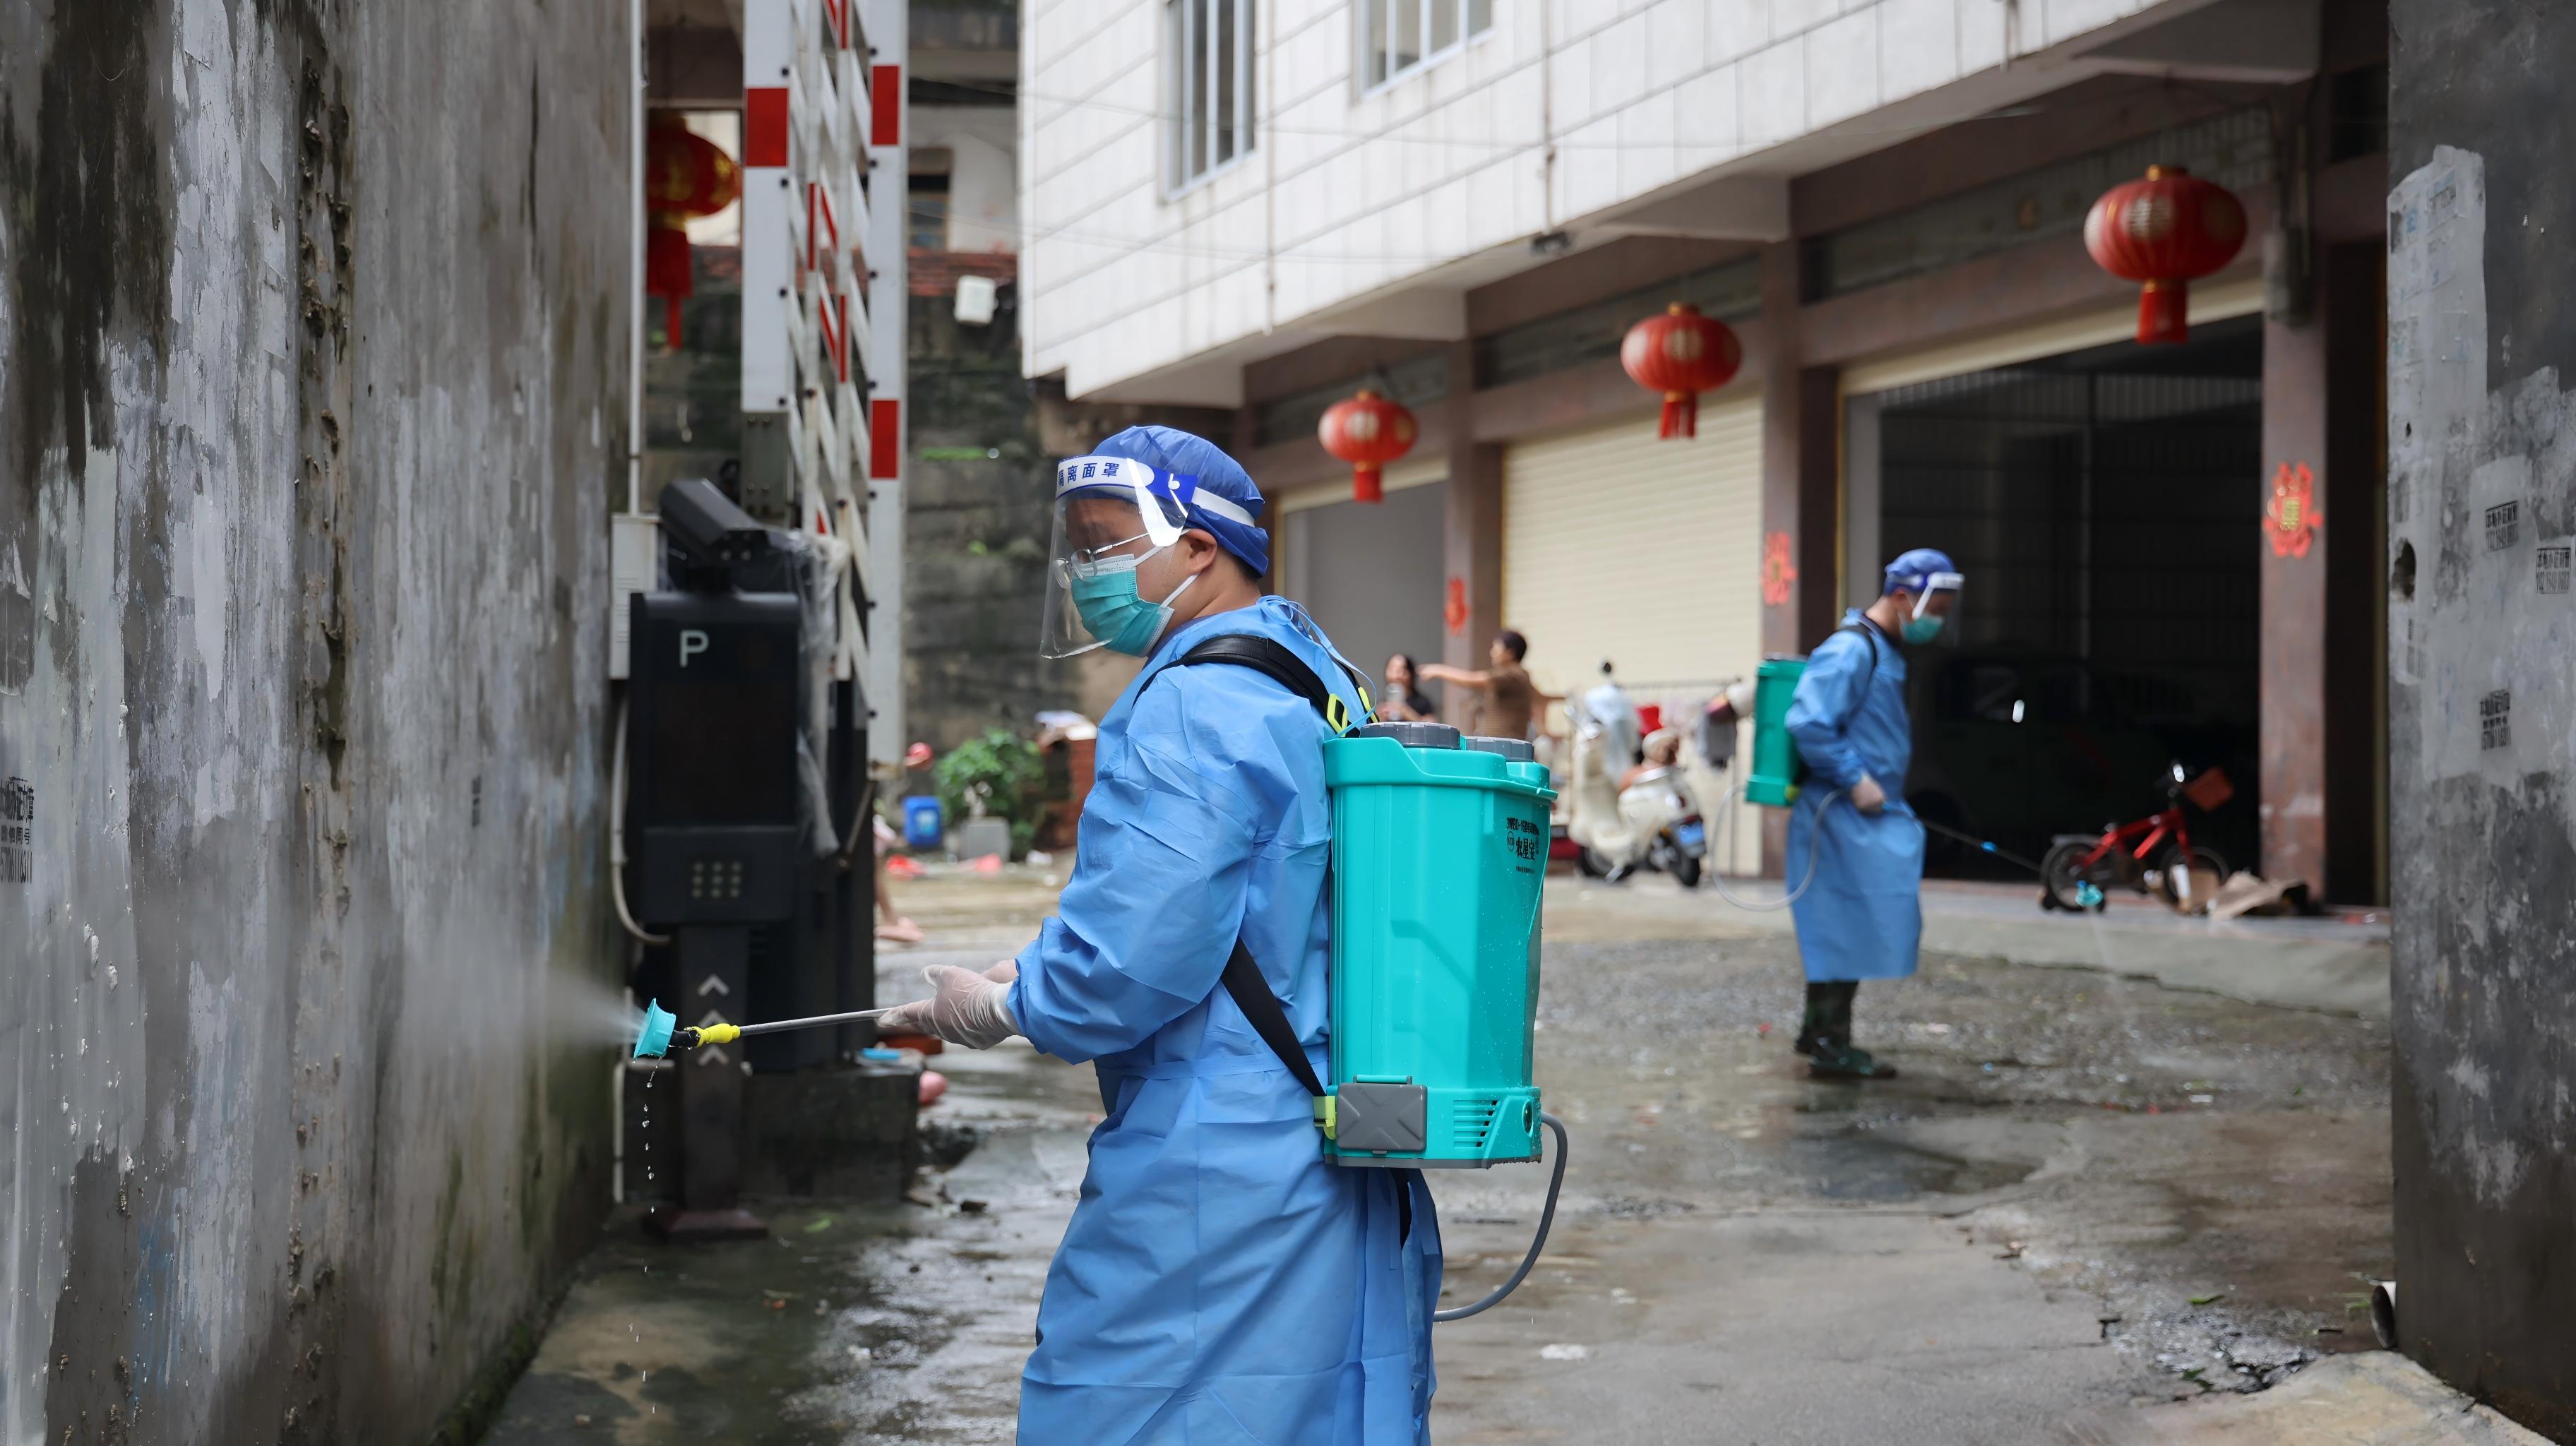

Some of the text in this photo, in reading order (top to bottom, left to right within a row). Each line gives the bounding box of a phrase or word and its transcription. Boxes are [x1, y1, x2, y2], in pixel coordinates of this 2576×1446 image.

[1059, 462, 1119, 487] 隔离面罩
[679, 630, 710, 668] P
